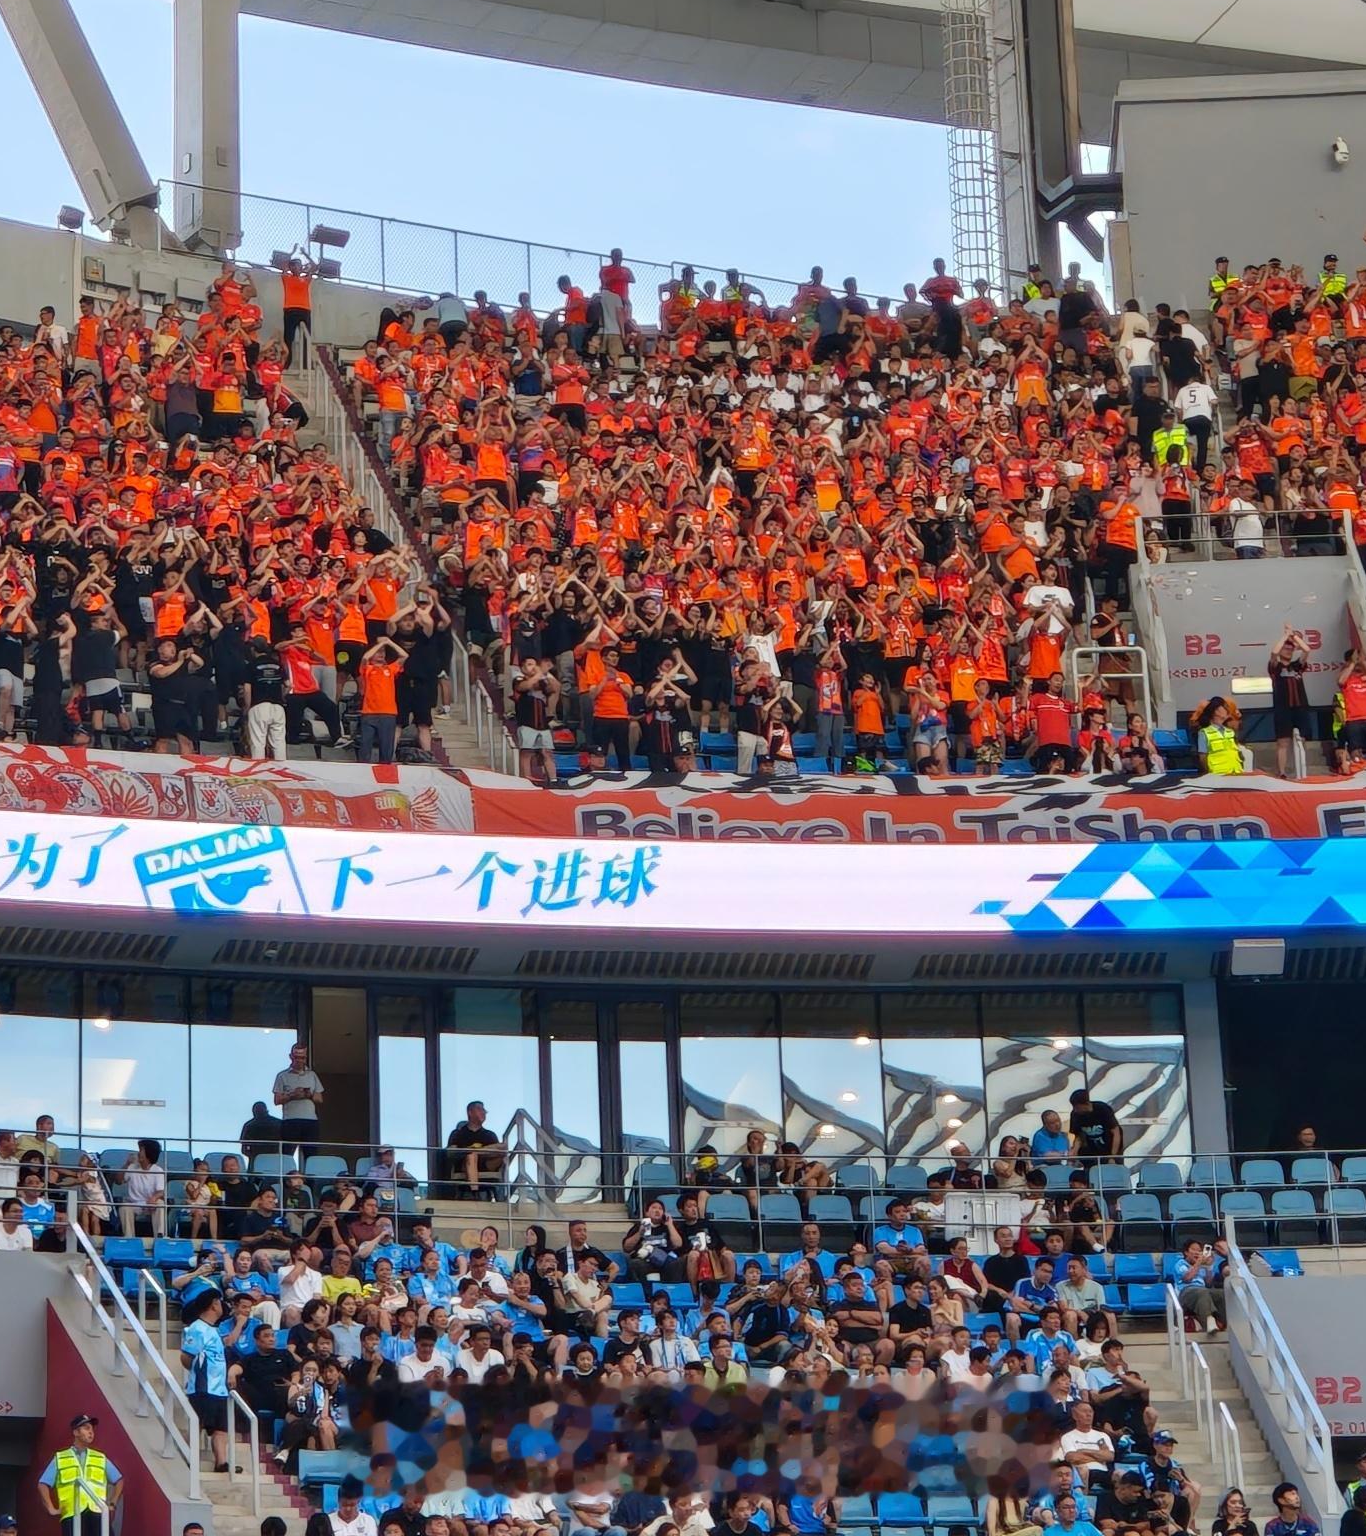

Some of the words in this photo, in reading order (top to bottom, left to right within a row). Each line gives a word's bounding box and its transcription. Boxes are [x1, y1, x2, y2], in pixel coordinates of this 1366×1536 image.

[1185, 634, 1222, 656] B2
[581, 809, 844, 841] Believe
[869, 816, 940, 843] In
[960, 812, 1265, 843] TaiShan
[145, 826, 274, 876] DALIAN
[314, 845, 662, 918] 下一个进球
[1315, 1376, 1362, 1405] B2
